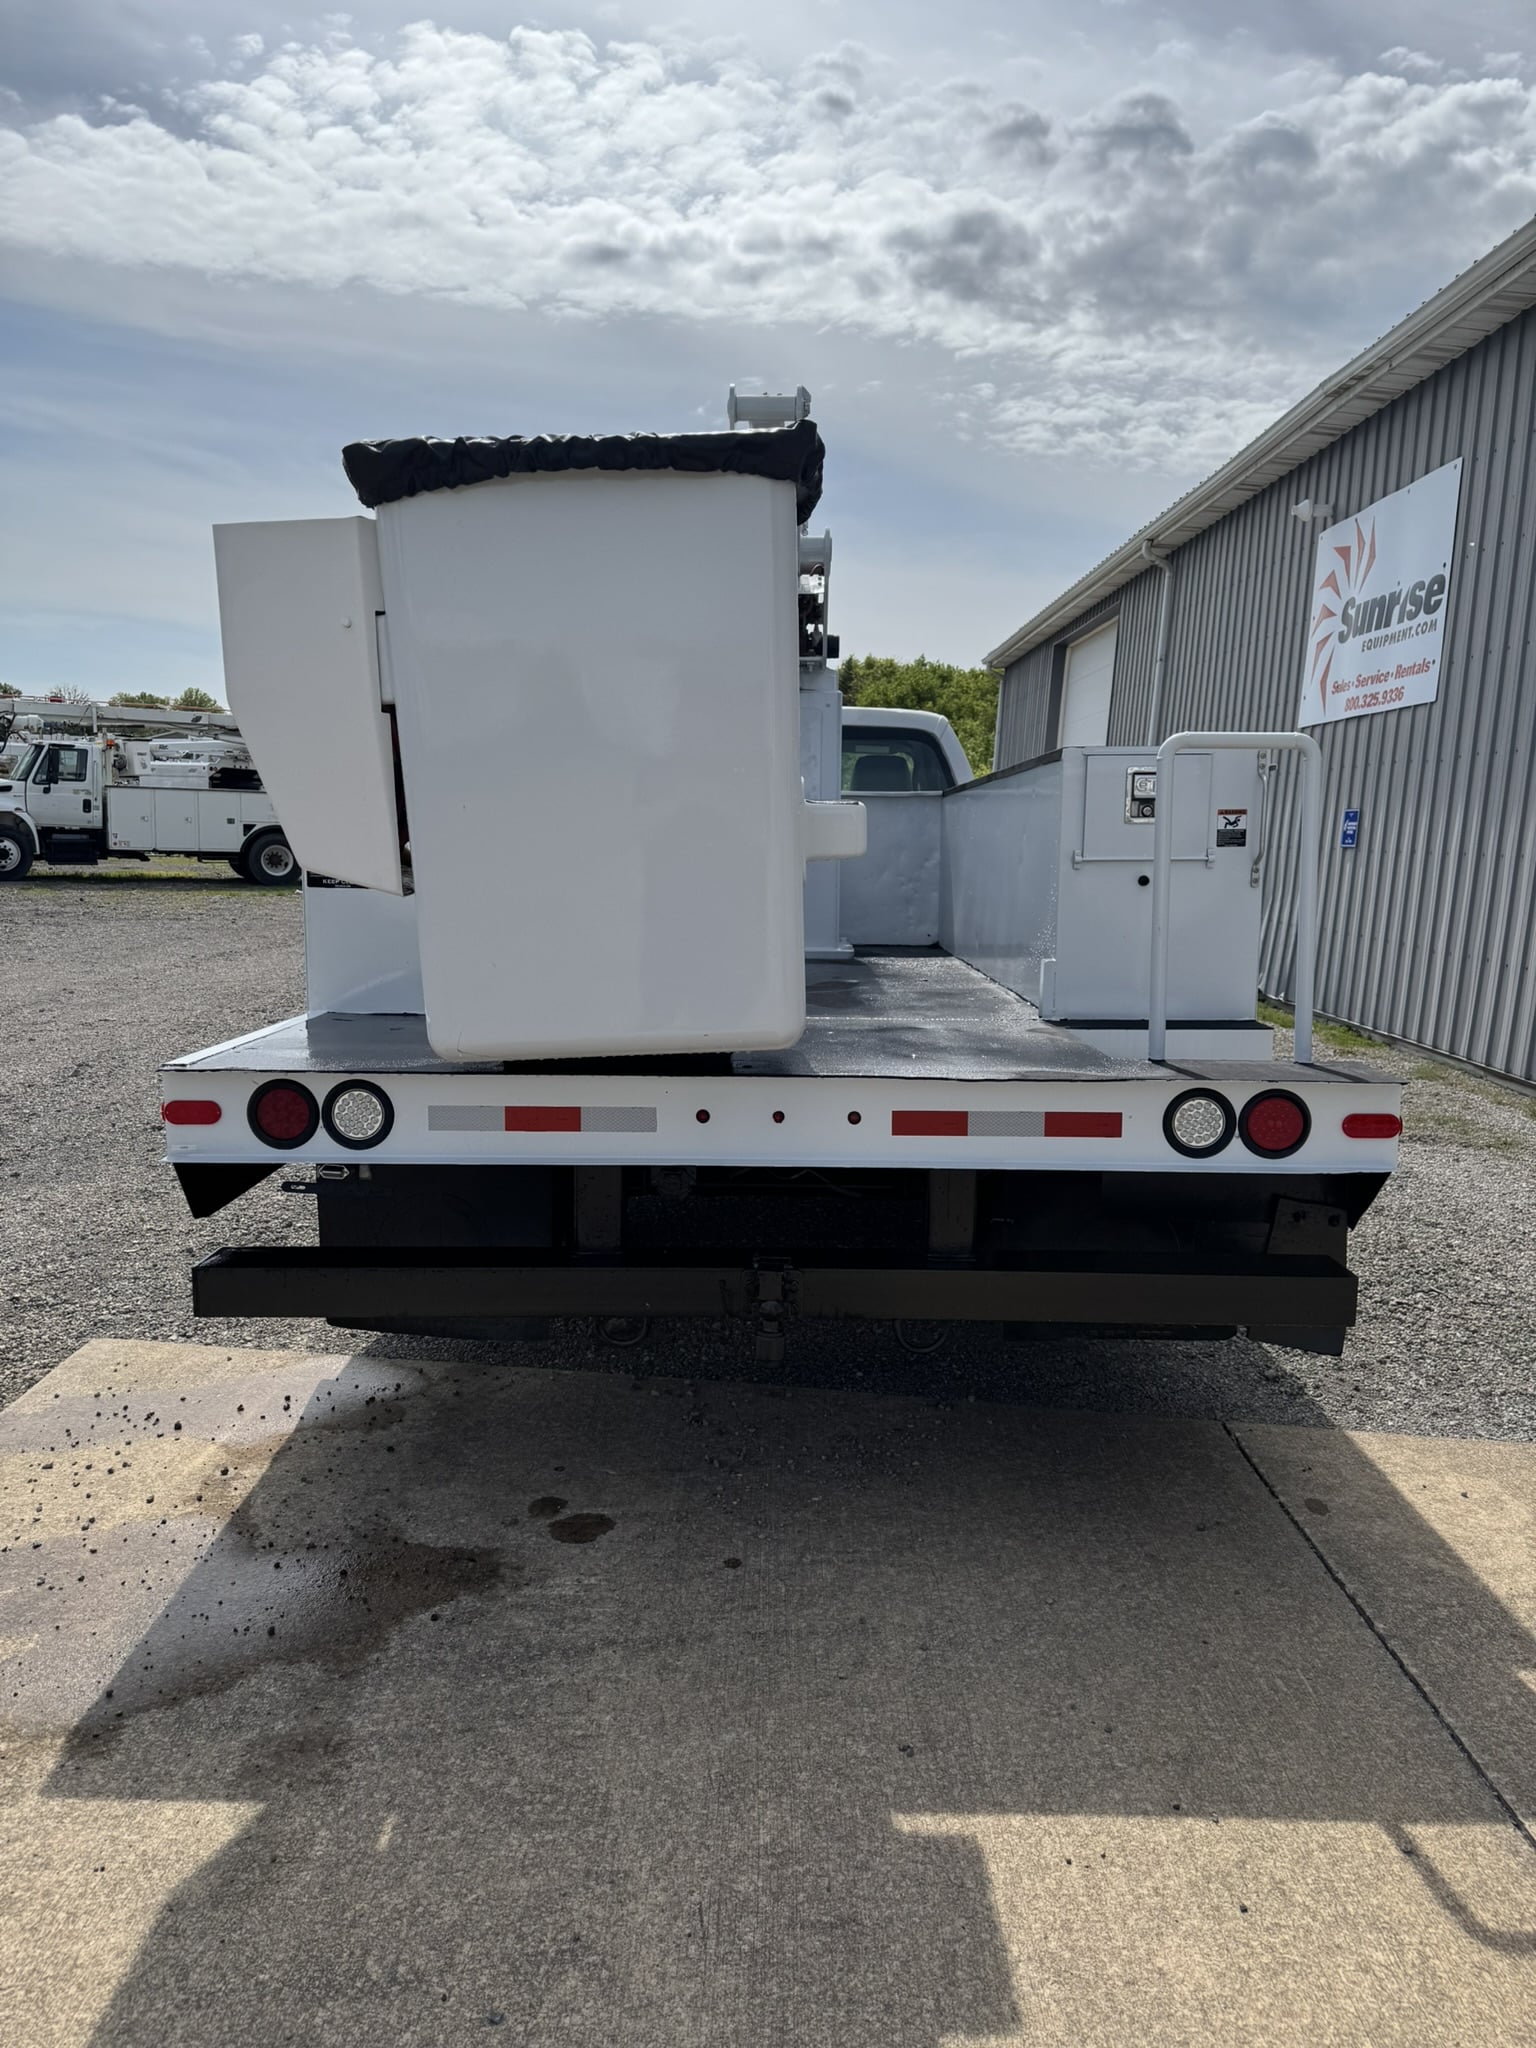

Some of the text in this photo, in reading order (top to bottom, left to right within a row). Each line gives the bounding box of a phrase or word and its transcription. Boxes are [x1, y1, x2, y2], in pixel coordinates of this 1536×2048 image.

[1338, 574, 1446, 644] Sunrise
[1361, 618, 1438, 652] EQUIPMENT.COM
[1332, 657, 1431, 695] Sales Service Rentals
[1344, 685, 1405, 713] 800.325.9336
